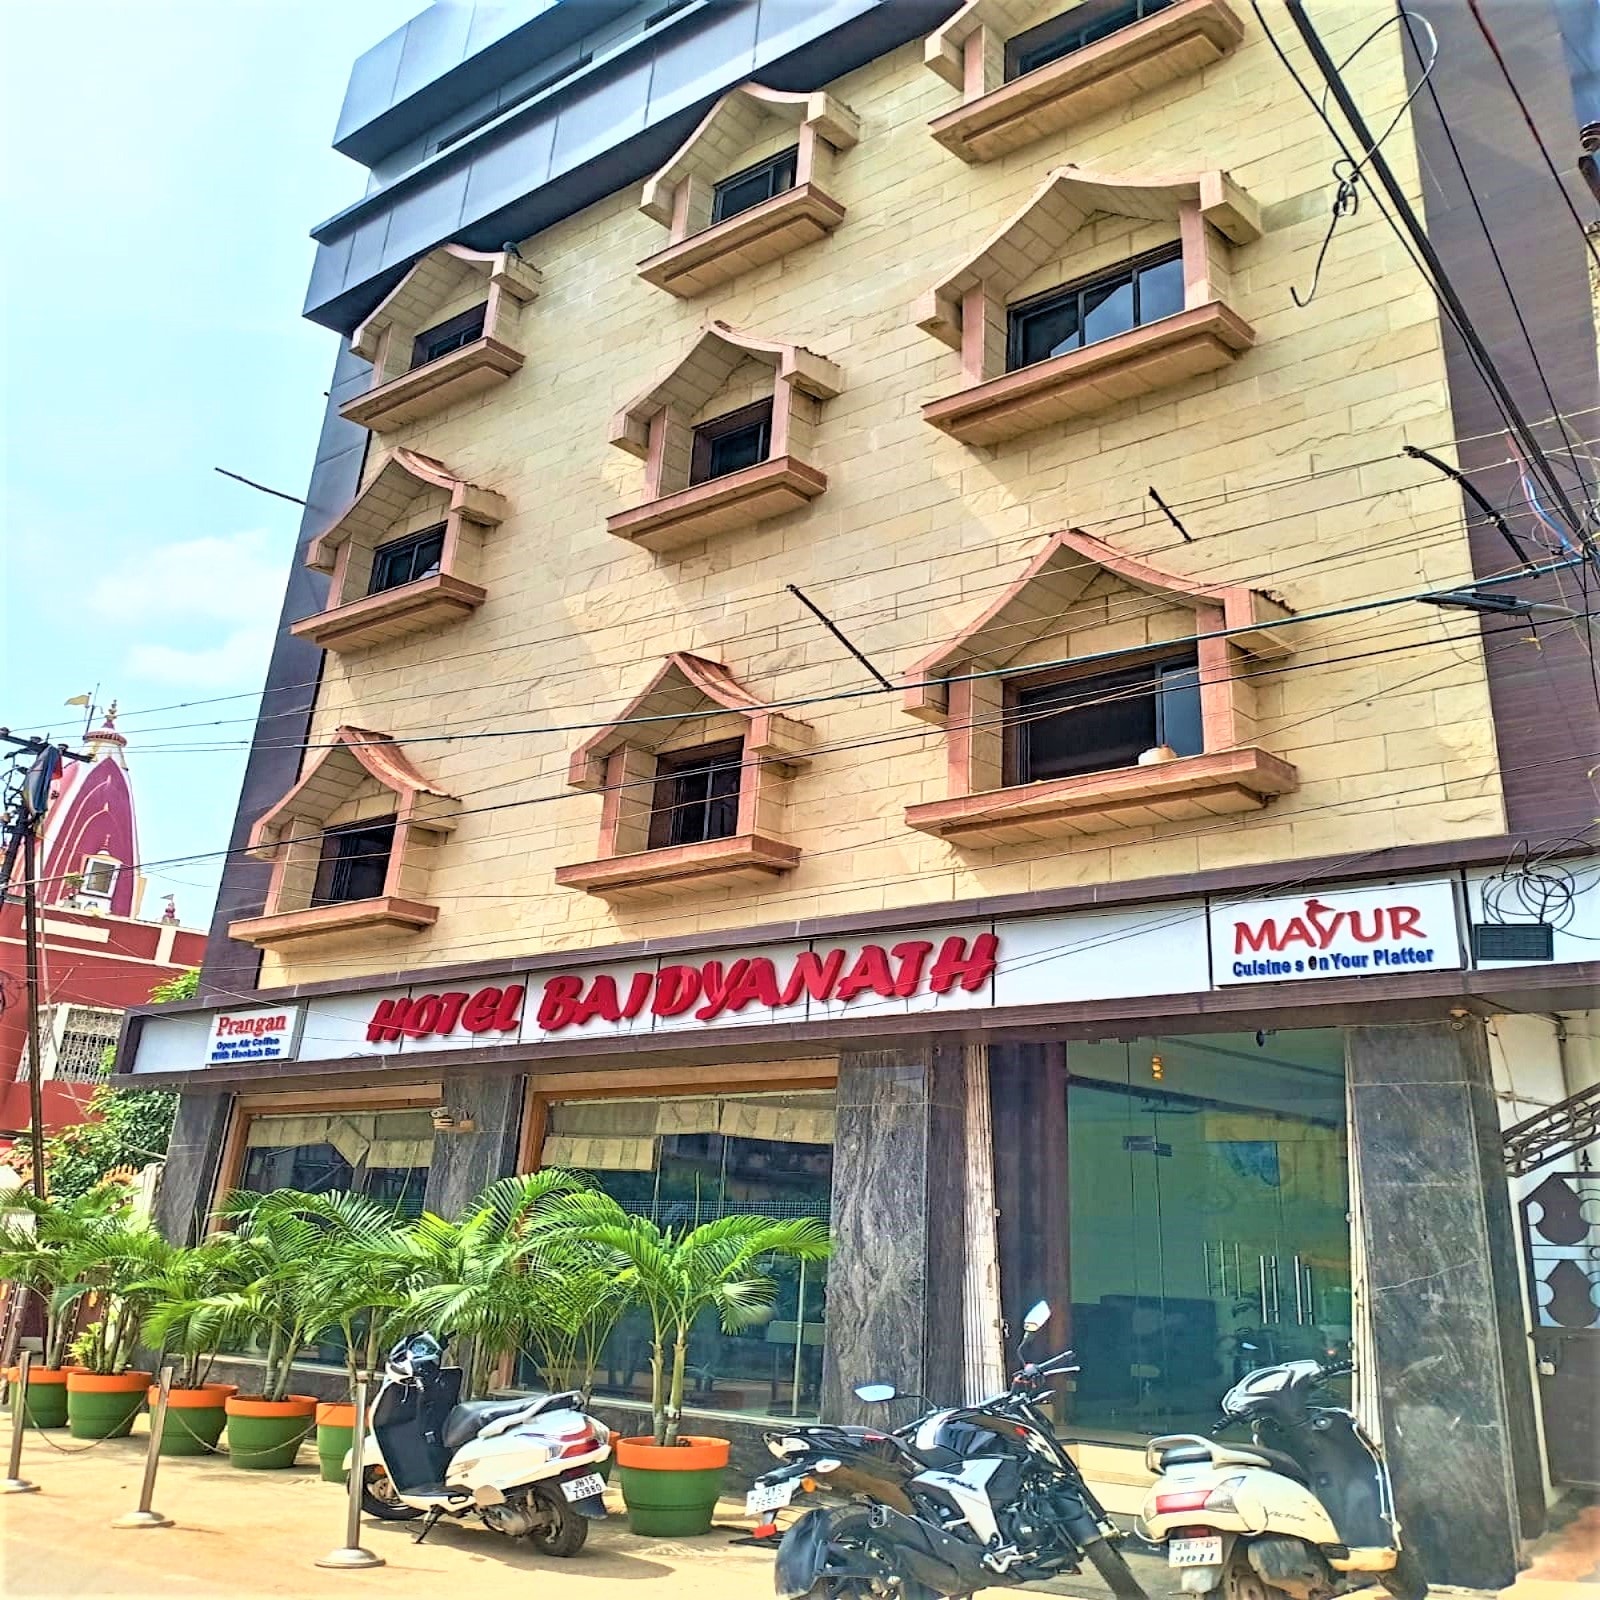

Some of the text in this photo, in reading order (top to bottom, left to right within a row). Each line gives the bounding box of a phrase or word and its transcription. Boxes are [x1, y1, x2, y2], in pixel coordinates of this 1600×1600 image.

[1233, 899, 1428, 955] MAYUR
[1330, 953, 1369, 969] Your
[1373, 947, 1434, 966] Platter
[536, 933, 1000, 1032] BAIDYANATH
[216, 1015, 287, 1037] Prangan
[211, 1047, 281, 1061] With Hookah Bar
[216, 1041, 237, 1051] Open
[239, 1039, 251, 1048] Air
[574, 1476, 596, 1489] JH15
